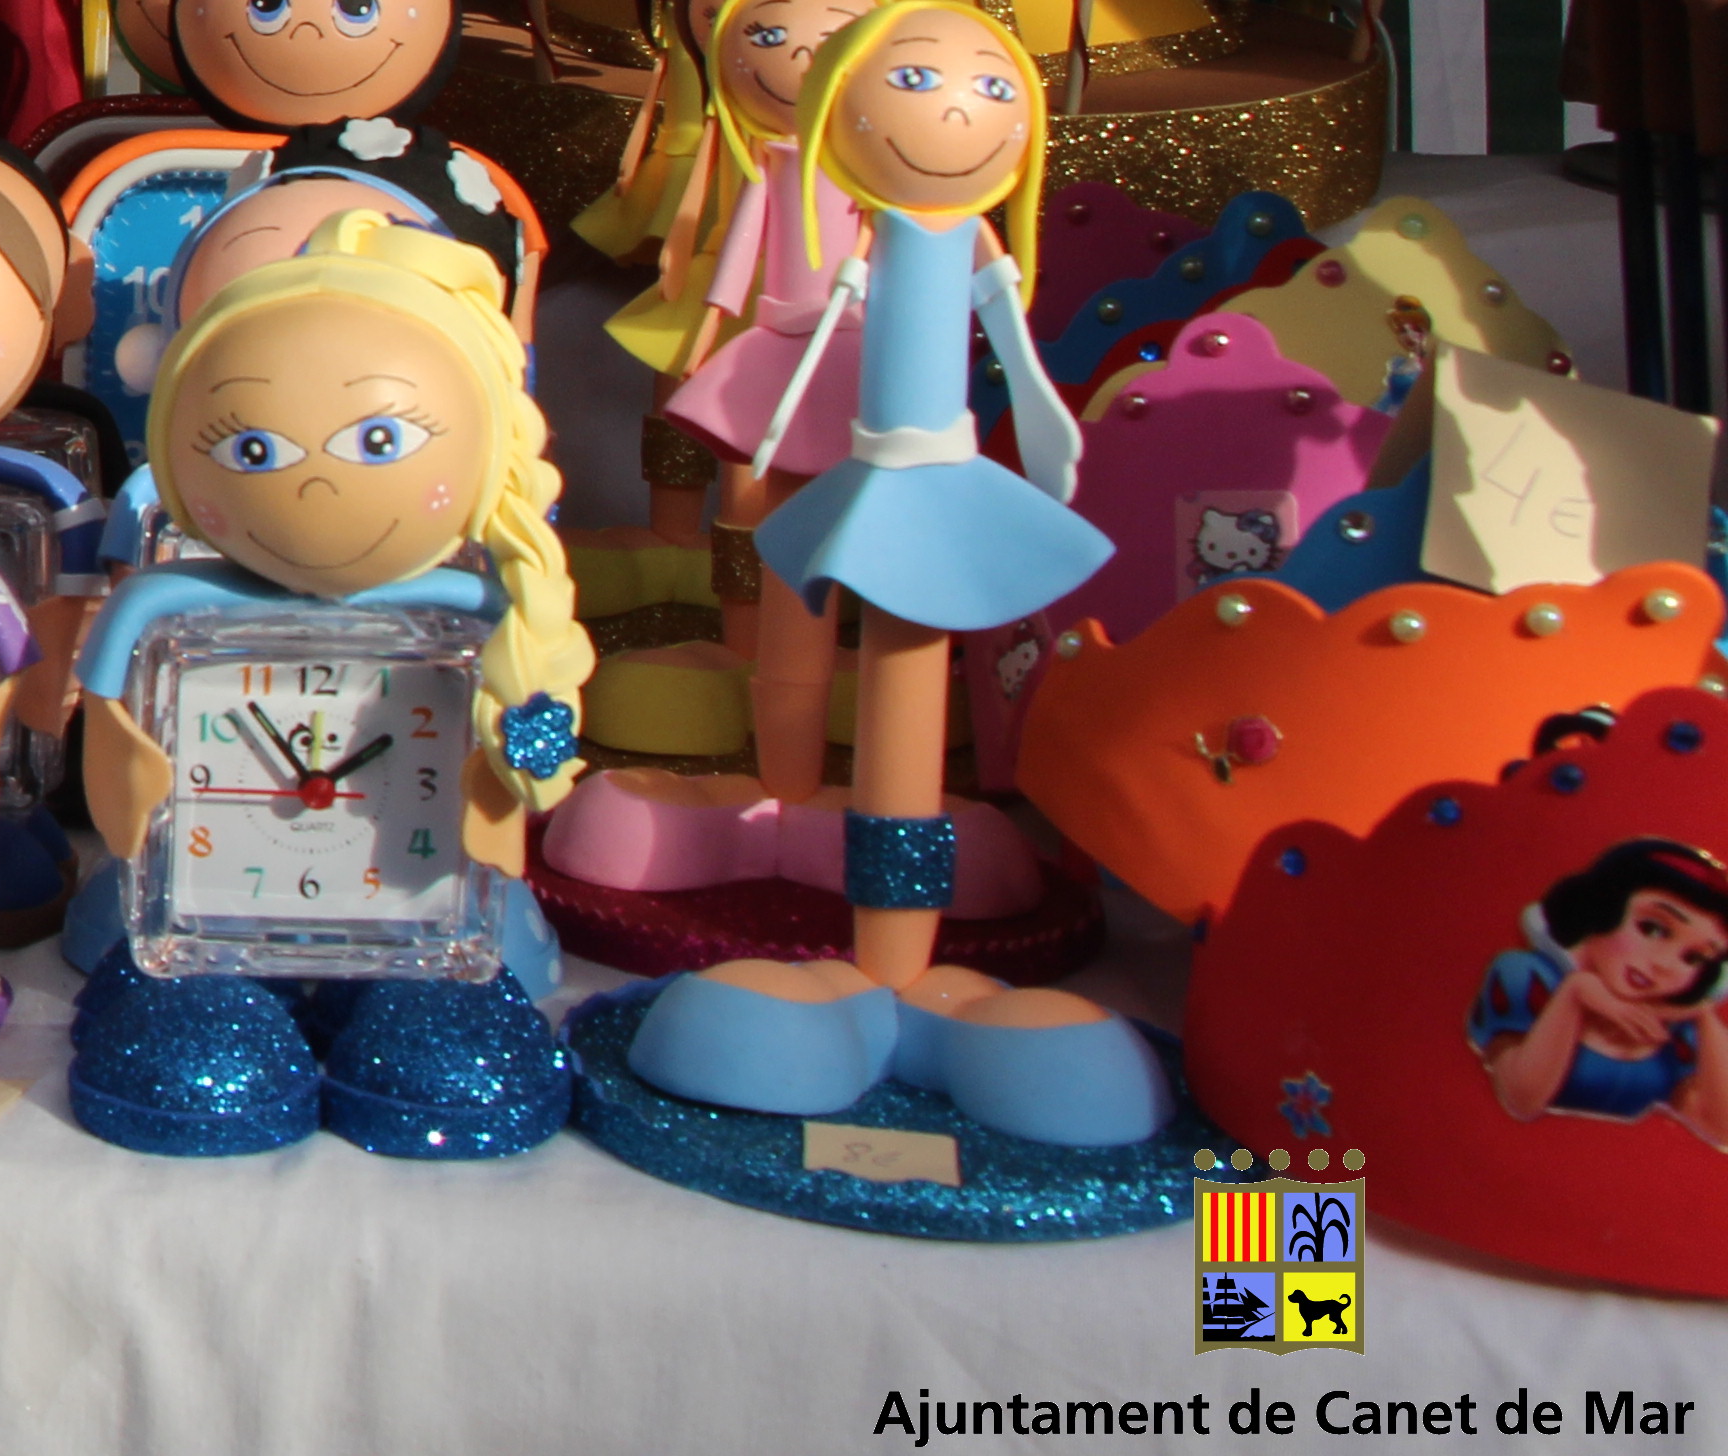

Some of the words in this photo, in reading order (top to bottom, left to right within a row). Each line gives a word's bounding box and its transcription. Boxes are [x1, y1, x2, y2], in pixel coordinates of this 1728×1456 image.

[238, 665, 273, 696] 11
[295, 665, 338, 696] 12
[378, 667, 392, 697] 1
[198, 712, 241, 743] 10
[410, 706, 438, 738] 2
[190, 764, 211, 798] 9
[417, 768, 438, 801] 3
[188, 826, 213, 858] 8
[407, 828, 436, 858] 4
[244, 867, 265, 899] 7
[299, 867, 320, 899] 6
[362, 868, 381, 899] 5
